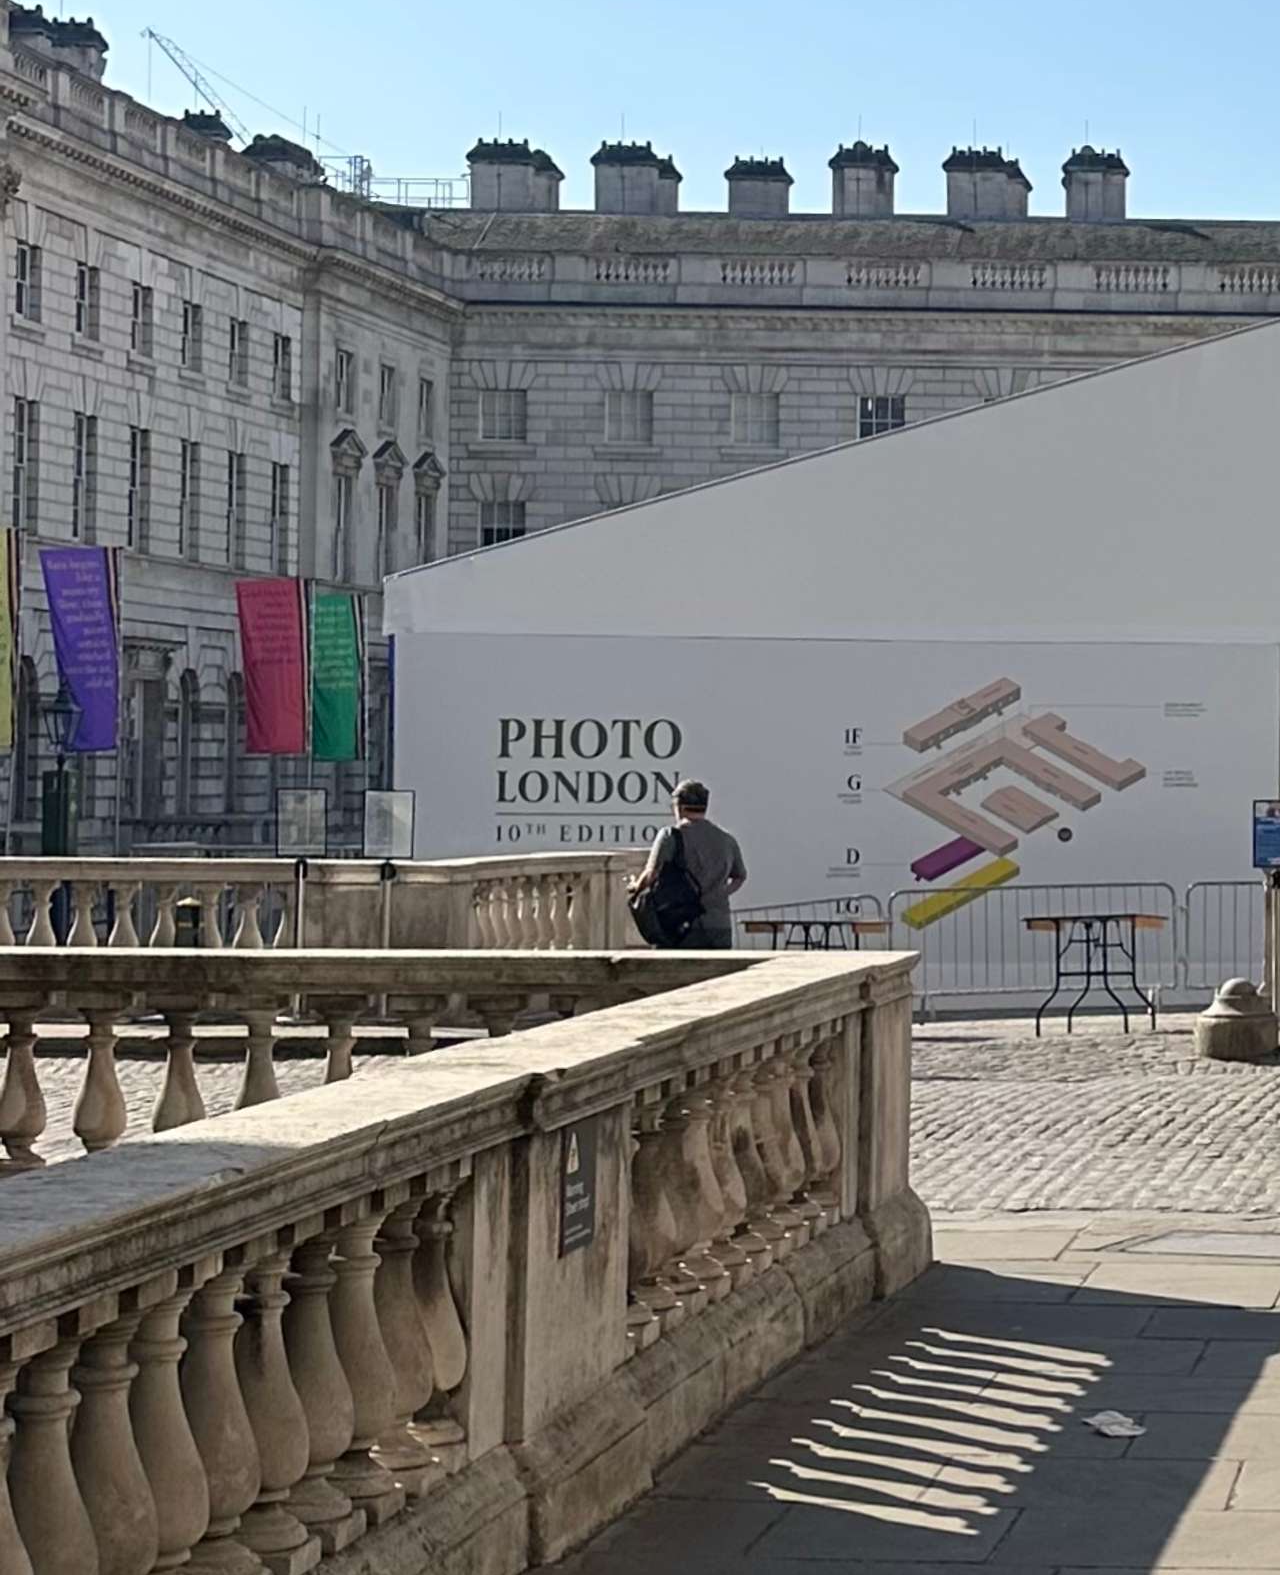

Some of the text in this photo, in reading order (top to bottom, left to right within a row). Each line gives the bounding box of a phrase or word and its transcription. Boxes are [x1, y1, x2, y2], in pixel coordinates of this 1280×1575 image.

[497, 718, 683, 760] PHOTO
[496, 770, 681, 804] LONDON
[847, 774, 862, 791] G
[496, 823, 657, 843] 10TH EDITIO
[846, 848, 860, 865] D
